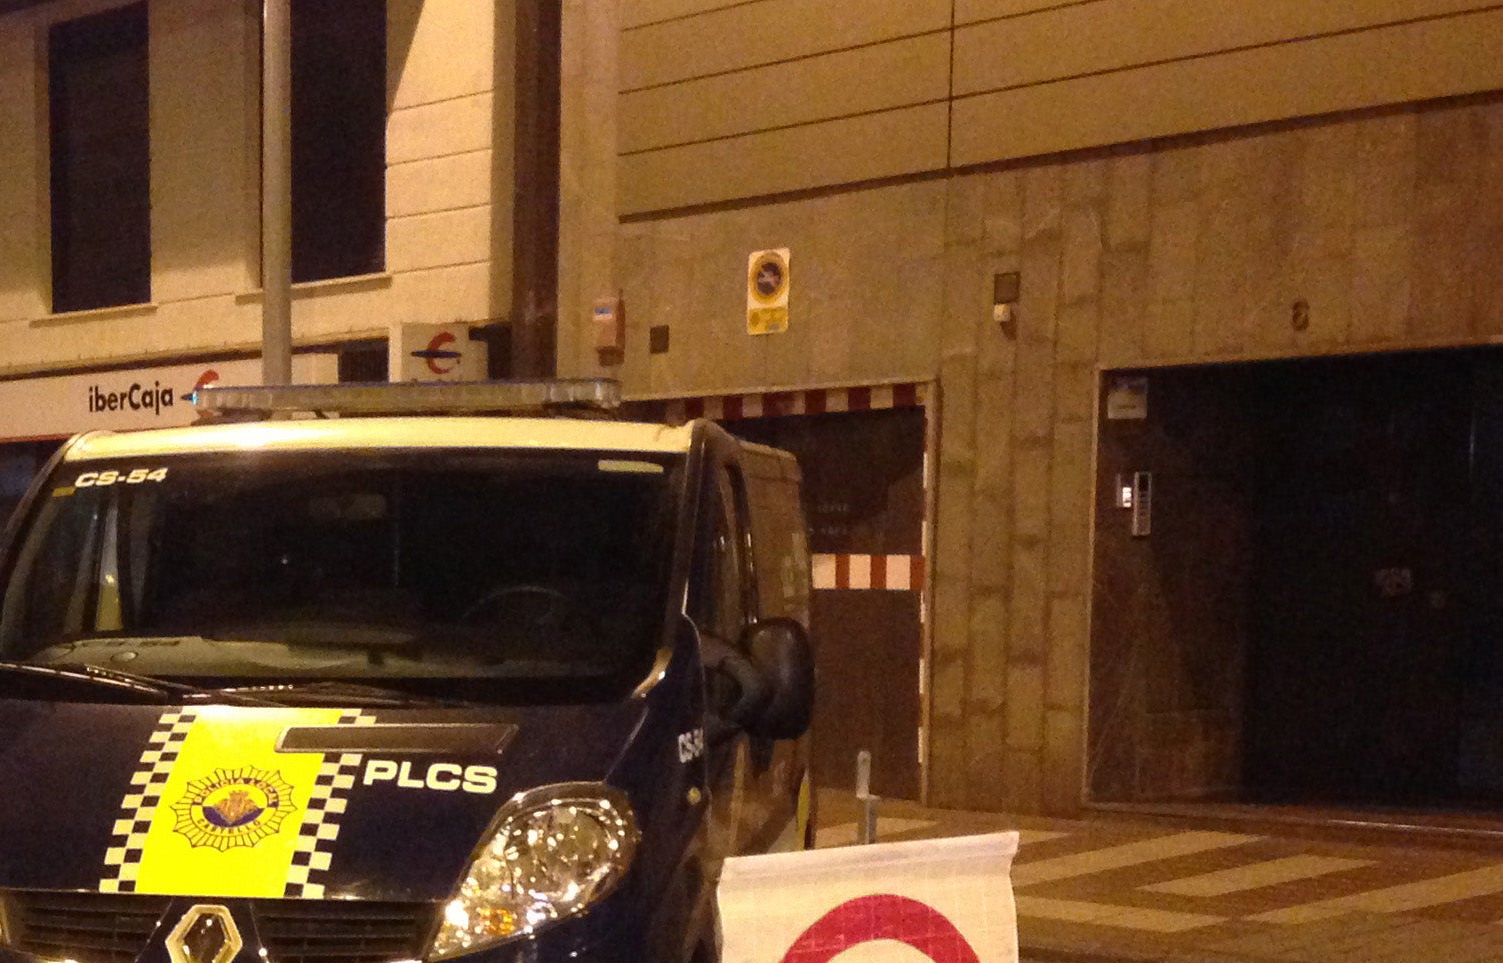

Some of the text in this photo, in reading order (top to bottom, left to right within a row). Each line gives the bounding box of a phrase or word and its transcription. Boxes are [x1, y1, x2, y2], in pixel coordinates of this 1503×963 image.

[89, 380, 174, 416] iberCaja
[75, 467, 168, 488] CS-54
[194, 778, 245, 804] POLICIA
[363, 759, 499, 795] PLCS
